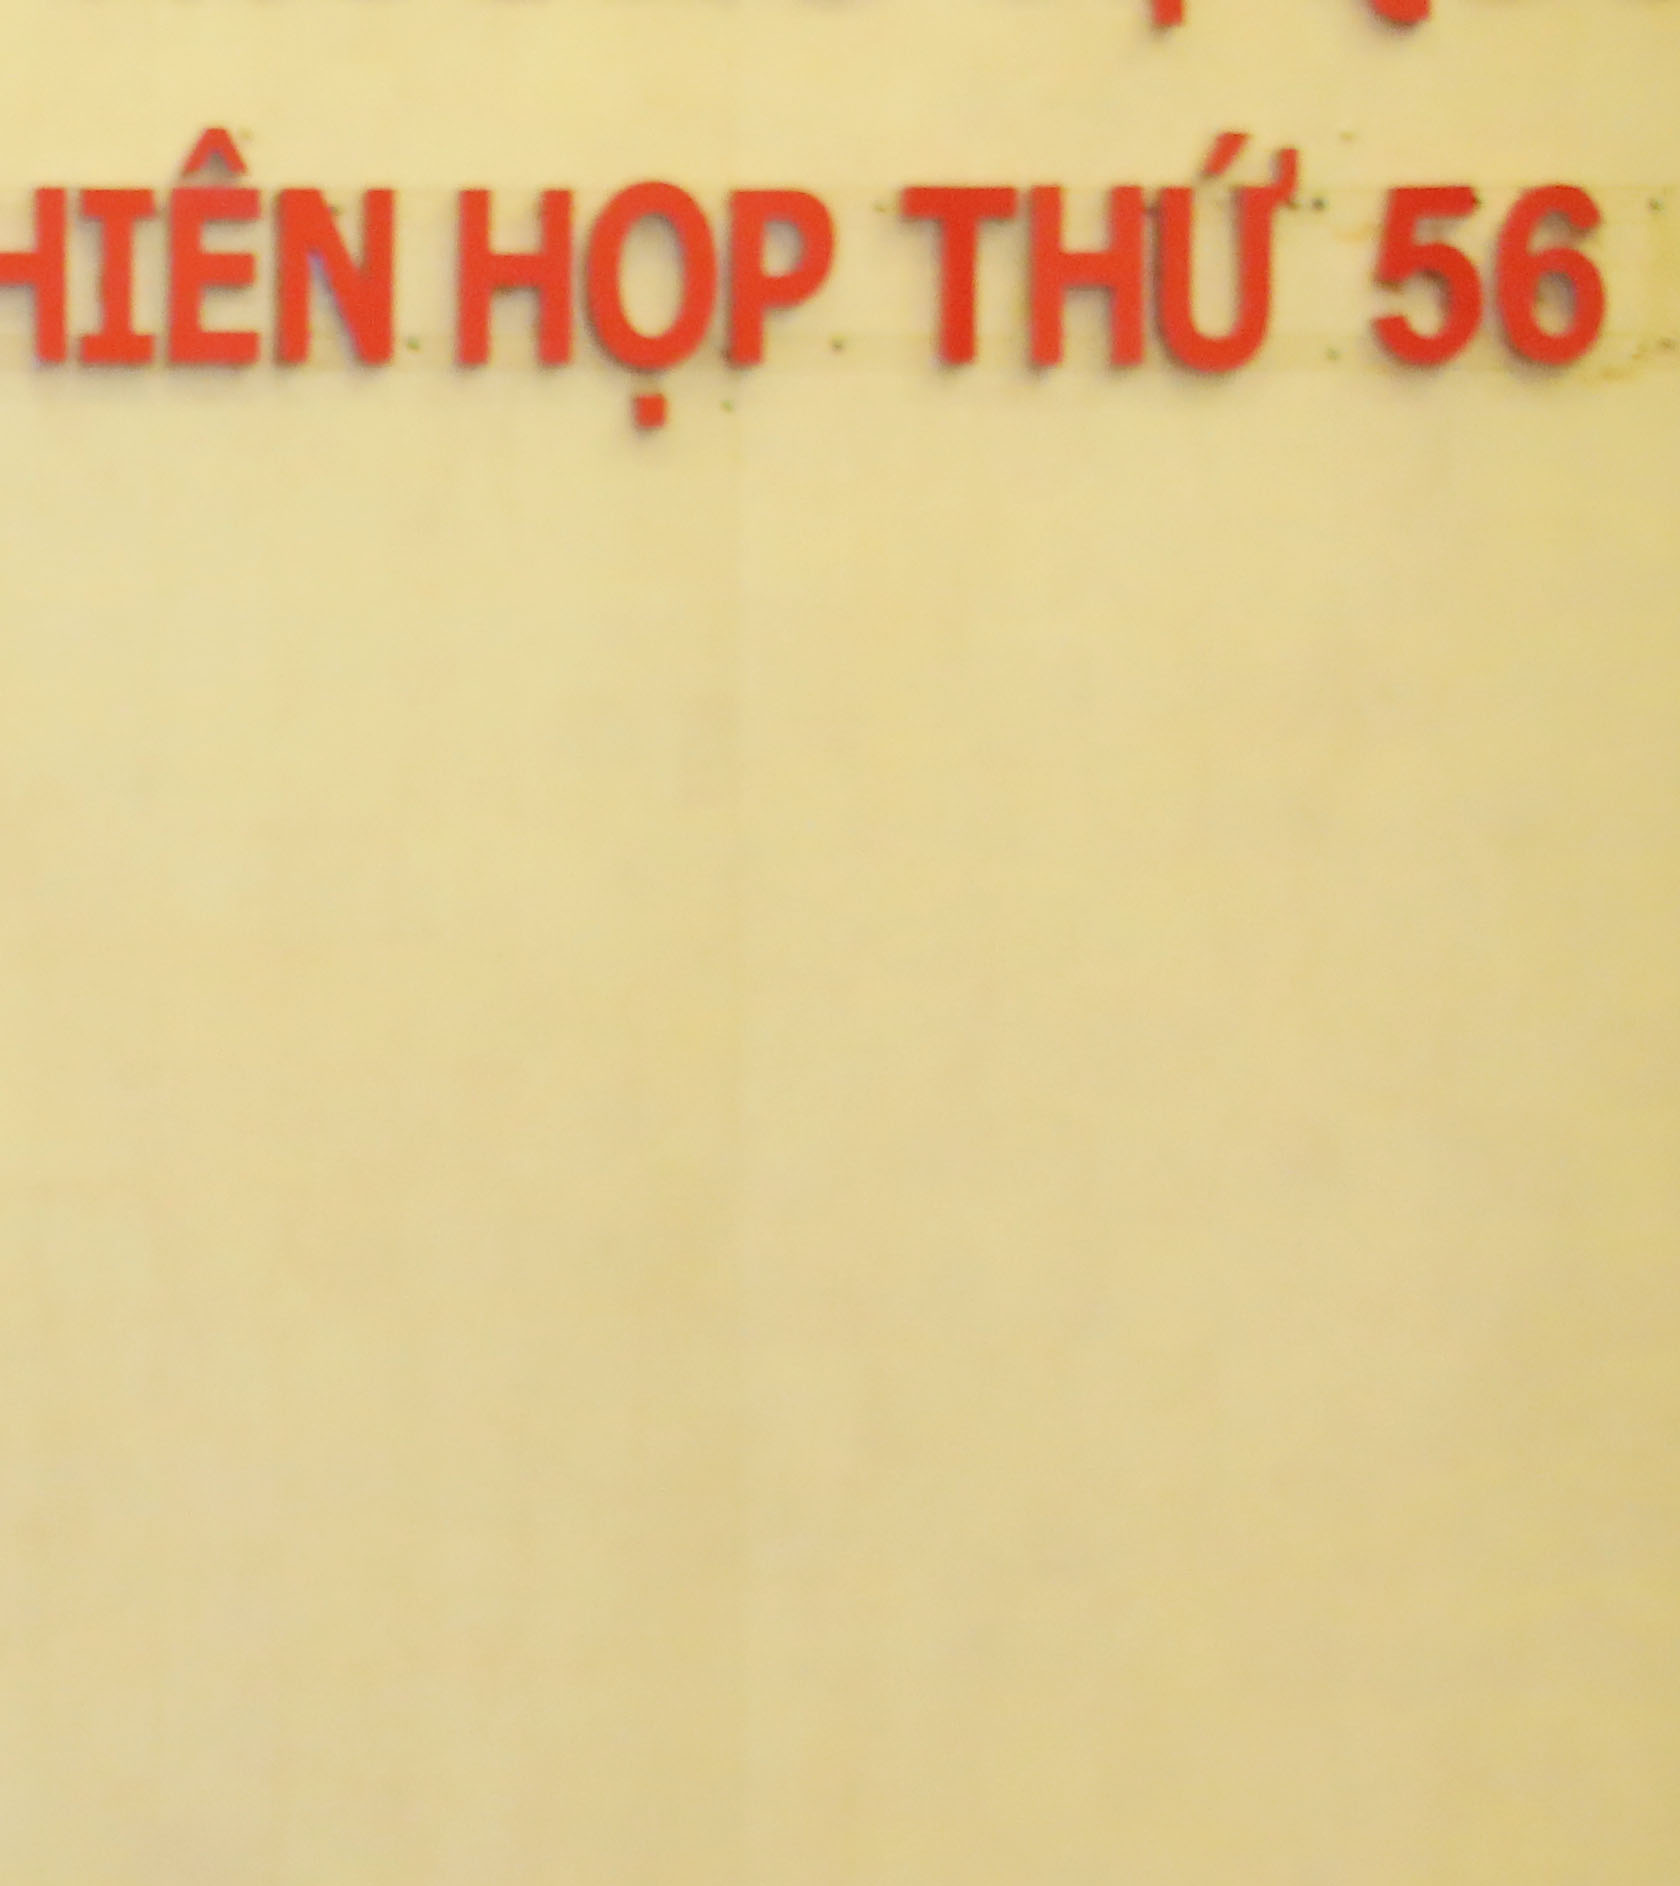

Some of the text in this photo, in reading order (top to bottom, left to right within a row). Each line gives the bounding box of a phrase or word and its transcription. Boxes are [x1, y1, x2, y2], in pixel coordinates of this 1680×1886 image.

[457, 181, 835, 428] HỌP
[900, 132, 1298, 373] THỨ
[1374, 184, 1605, 367] 56
